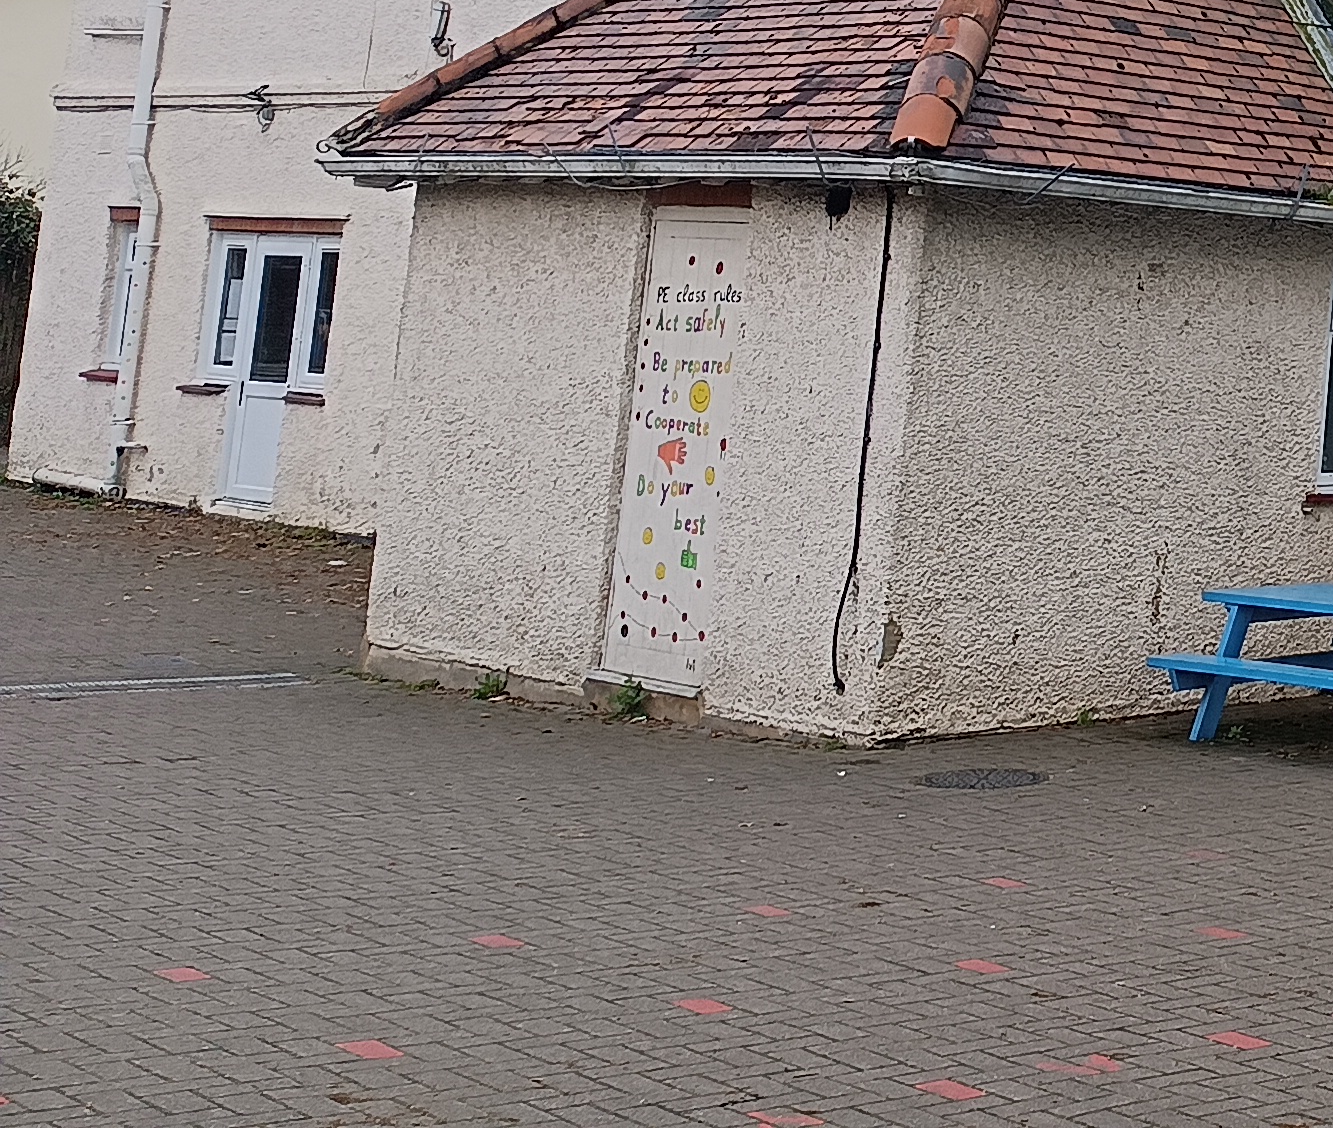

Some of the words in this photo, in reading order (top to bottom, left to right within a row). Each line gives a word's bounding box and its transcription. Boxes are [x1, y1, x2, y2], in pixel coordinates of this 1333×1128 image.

[657, 286, 670, 303] PE
[676, 284, 706, 302] class
[714, 284, 742, 302] rules
[656, 308, 678, 332] Act
[686, 304, 726, 338] safely
[652, 352, 668, 372] Be
[673, 351, 733, 381] prepared
[662, 384, 679, 405] to
[645, 410, 710, 436] Cooperate
[637, 474, 655, 497] Do
[660, 480, 694, 507] your
[674, 508, 706, 536] best
